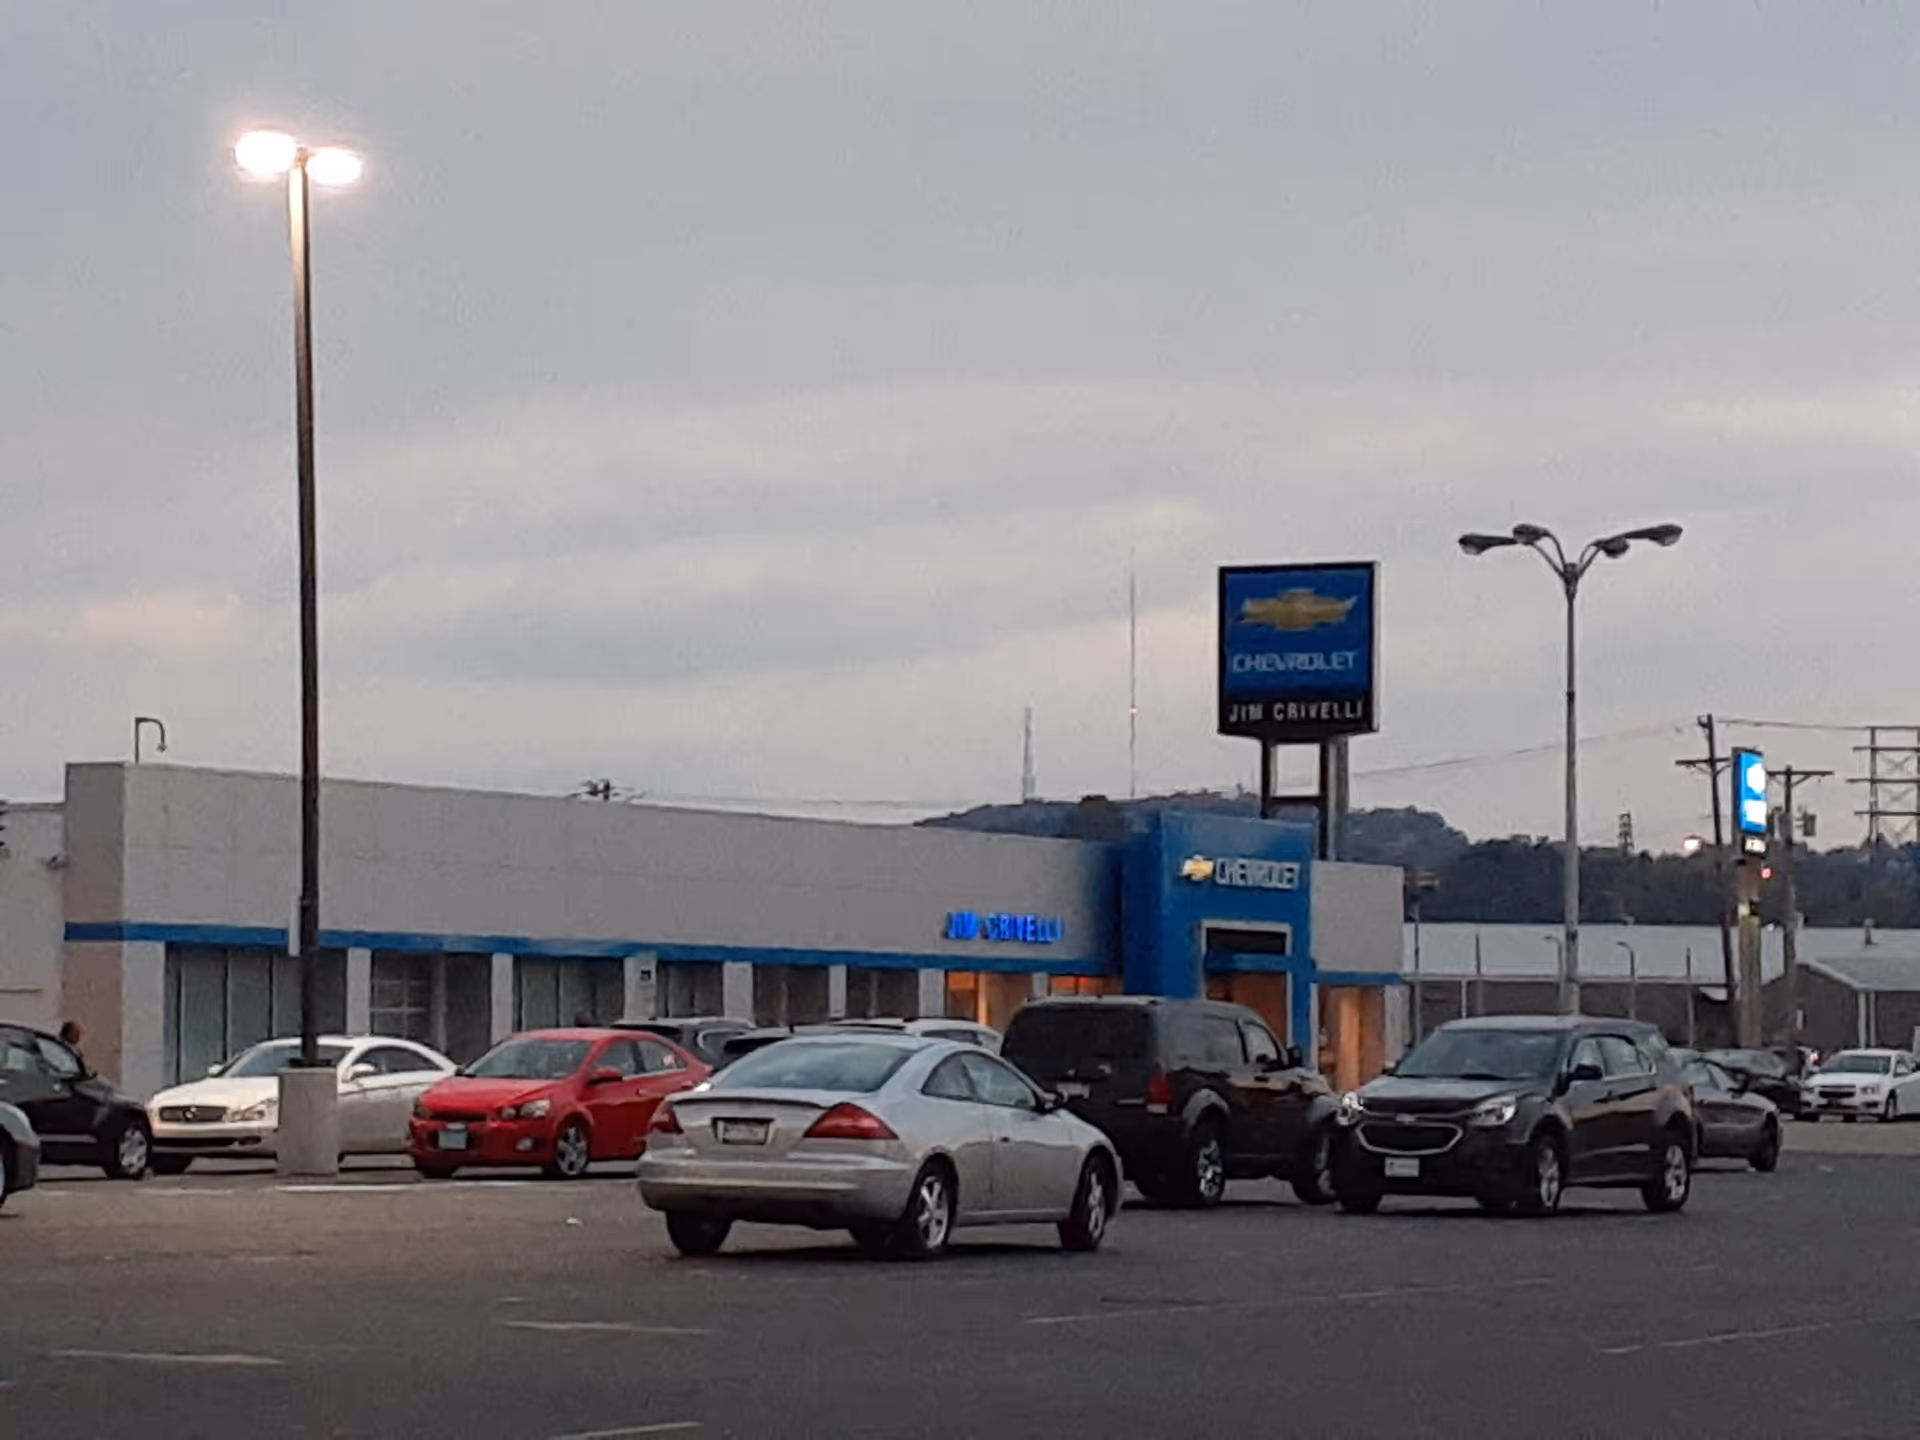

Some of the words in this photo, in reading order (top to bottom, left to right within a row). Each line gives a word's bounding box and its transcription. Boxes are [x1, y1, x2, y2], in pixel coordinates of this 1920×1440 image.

[1232, 651, 1358, 673] CHEVROLET
[1229, 704, 1263, 722] JIM
[1273, 701, 1363, 721] CRIVELLI
[1216, 858, 1300, 889] CHEVROLET
